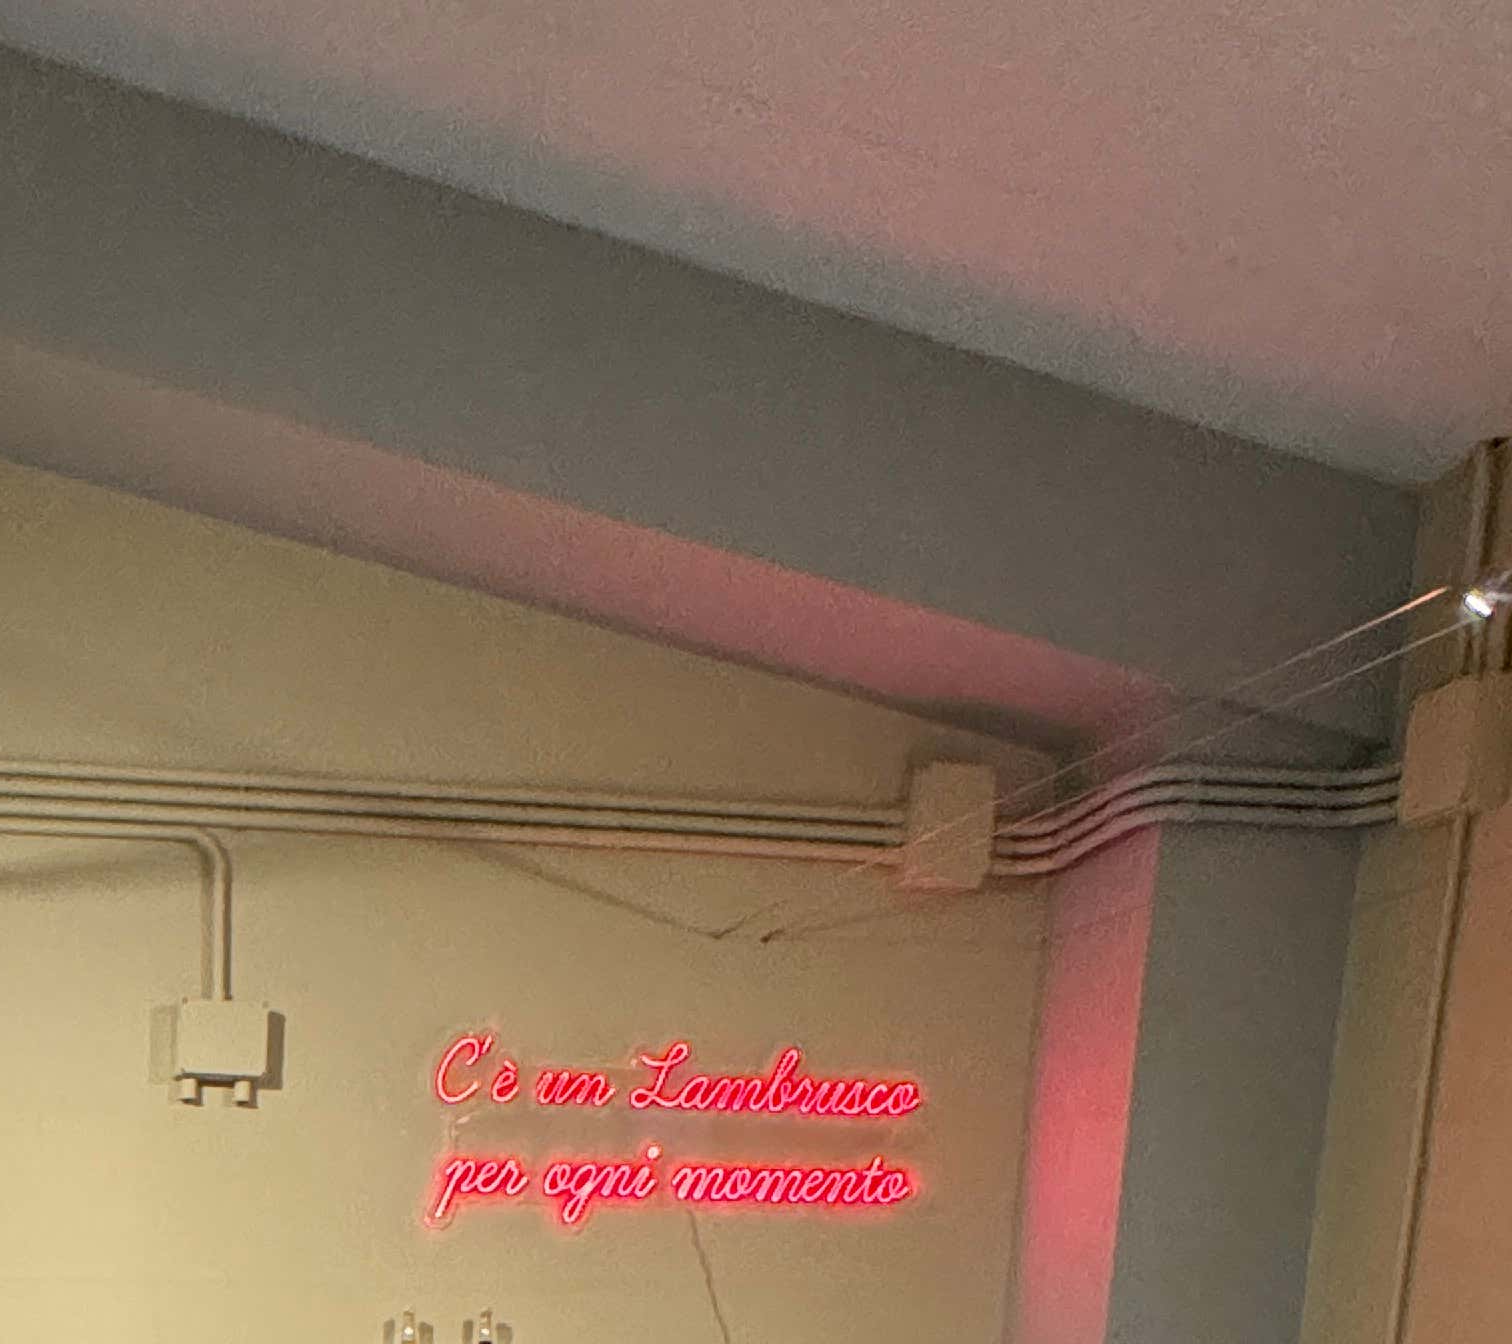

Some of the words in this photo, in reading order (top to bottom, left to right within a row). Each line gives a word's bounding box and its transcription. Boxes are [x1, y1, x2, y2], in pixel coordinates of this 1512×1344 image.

[435, 1033, 519, 1103] C'è
[535, 1068, 615, 1105] un
[629, 1043, 922, 1116] Lambrusco
[424, 1156, 529, 1228] per
[542, 1145, 661, 1224] ogni
[671, 1156, 912, 1205] momento
